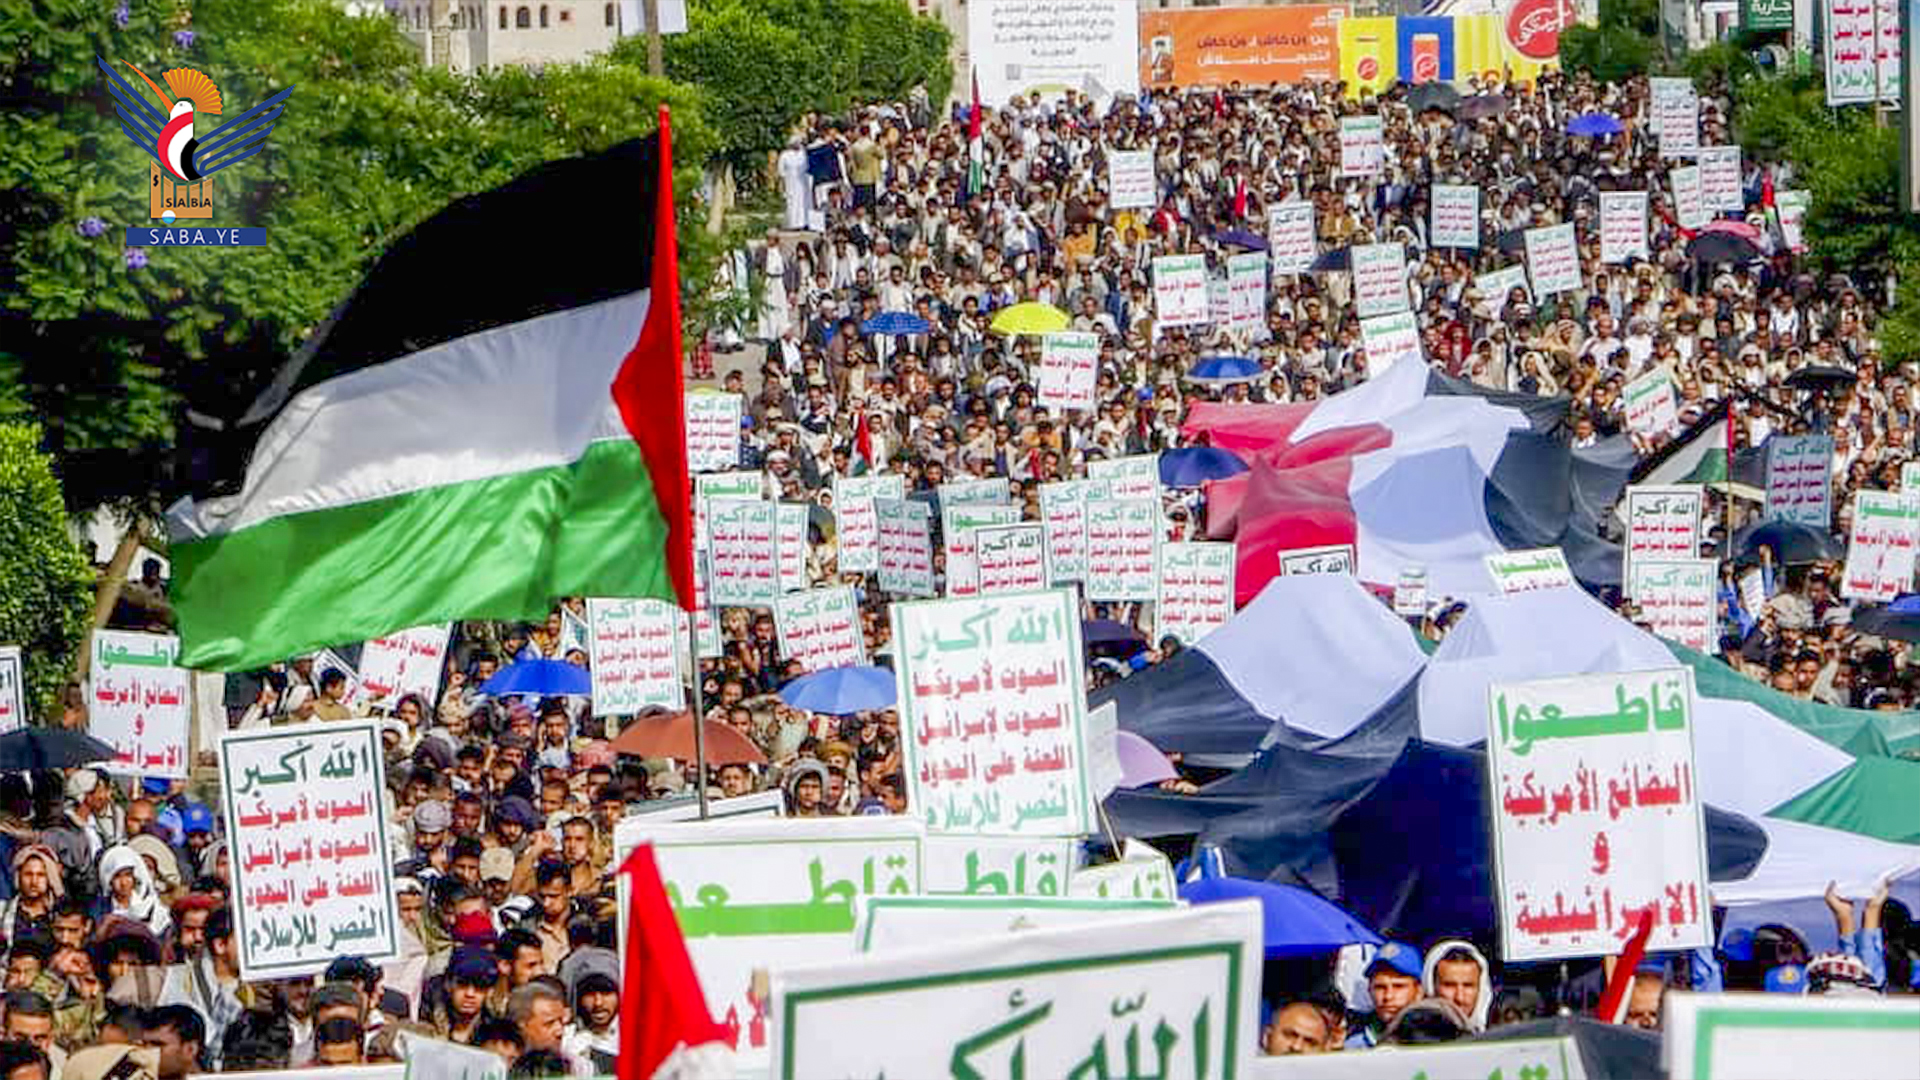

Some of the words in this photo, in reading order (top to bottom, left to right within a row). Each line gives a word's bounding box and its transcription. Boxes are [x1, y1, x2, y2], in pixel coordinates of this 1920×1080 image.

[911, 604, 1000, 664] أكبر
[913, 658, 994, 701] لأمريكا
[1001, 658, 1067, 694] الموت
[917, 707, 999, 747] لإسرائيل
[1004, 702, 1071, 736] الموت
[1497, 678, 1686, 757] قاطعوا
[234, 738, 315, 798] أكبر
[920, 751, 977, 789] اليهود
[984, 750, 1016, 783] على
[1023, 743, 1074, 771] اللعنة
[314, 791, 374, 824] الموت
[1011, 782, 1079, 831] النصر
[1502, 757, 1599, 826] الأمريكية
[1607, 759, 1691, 821] البضائع
[237, 792, 309, 830] لأمريكا
[926, 790, 1000, 834] للإسلام
[242, 834, 313, 873] لإسرائيل
[318, 831, 377, 864] الموت
[1592, 831, 1610, 875] و
[245, 878, 297, 911] اليهود
[303, 875, 329, 908] على
[336, 870, 381, 898] اللعنة
[249, 912, 318, 960] للإسلام
[324, 903, 386, 950] النصر
